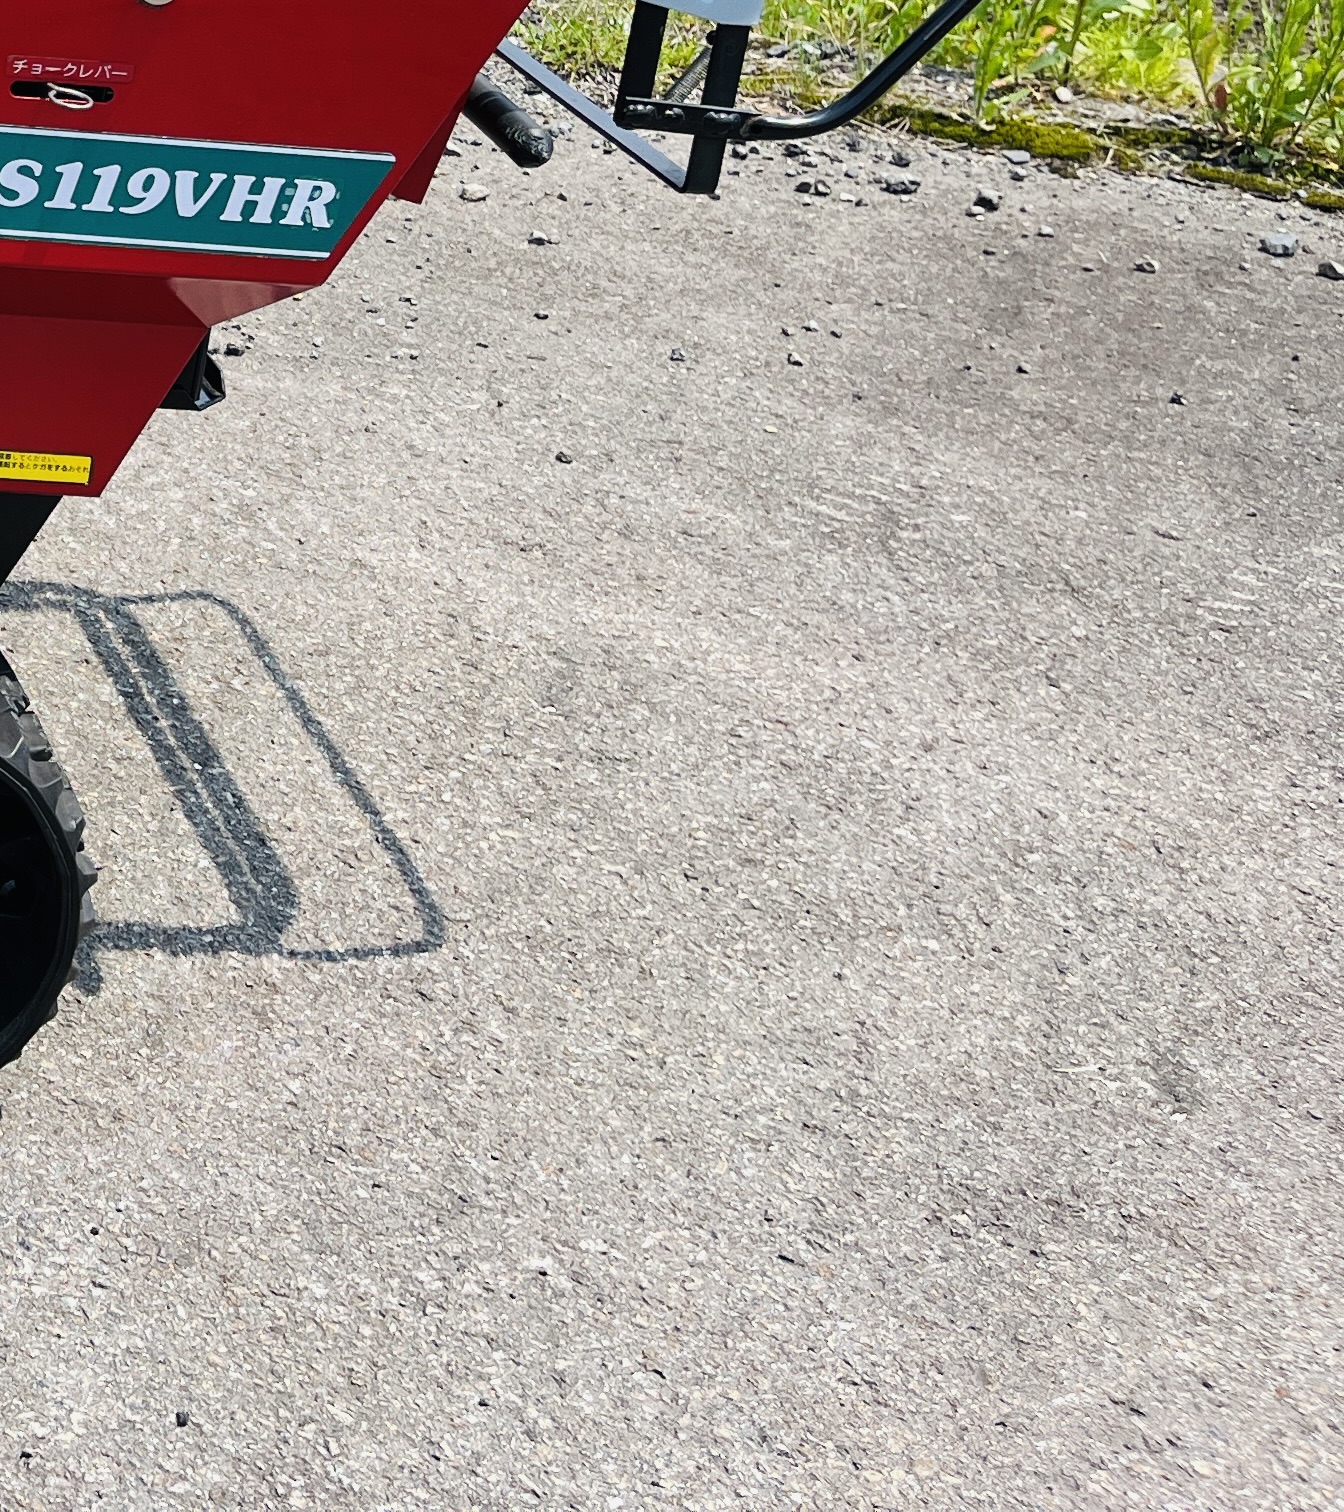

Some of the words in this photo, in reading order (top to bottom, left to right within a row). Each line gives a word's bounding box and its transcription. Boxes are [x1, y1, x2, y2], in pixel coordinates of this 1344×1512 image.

[12, 59, 128, 79] チョークレバー
